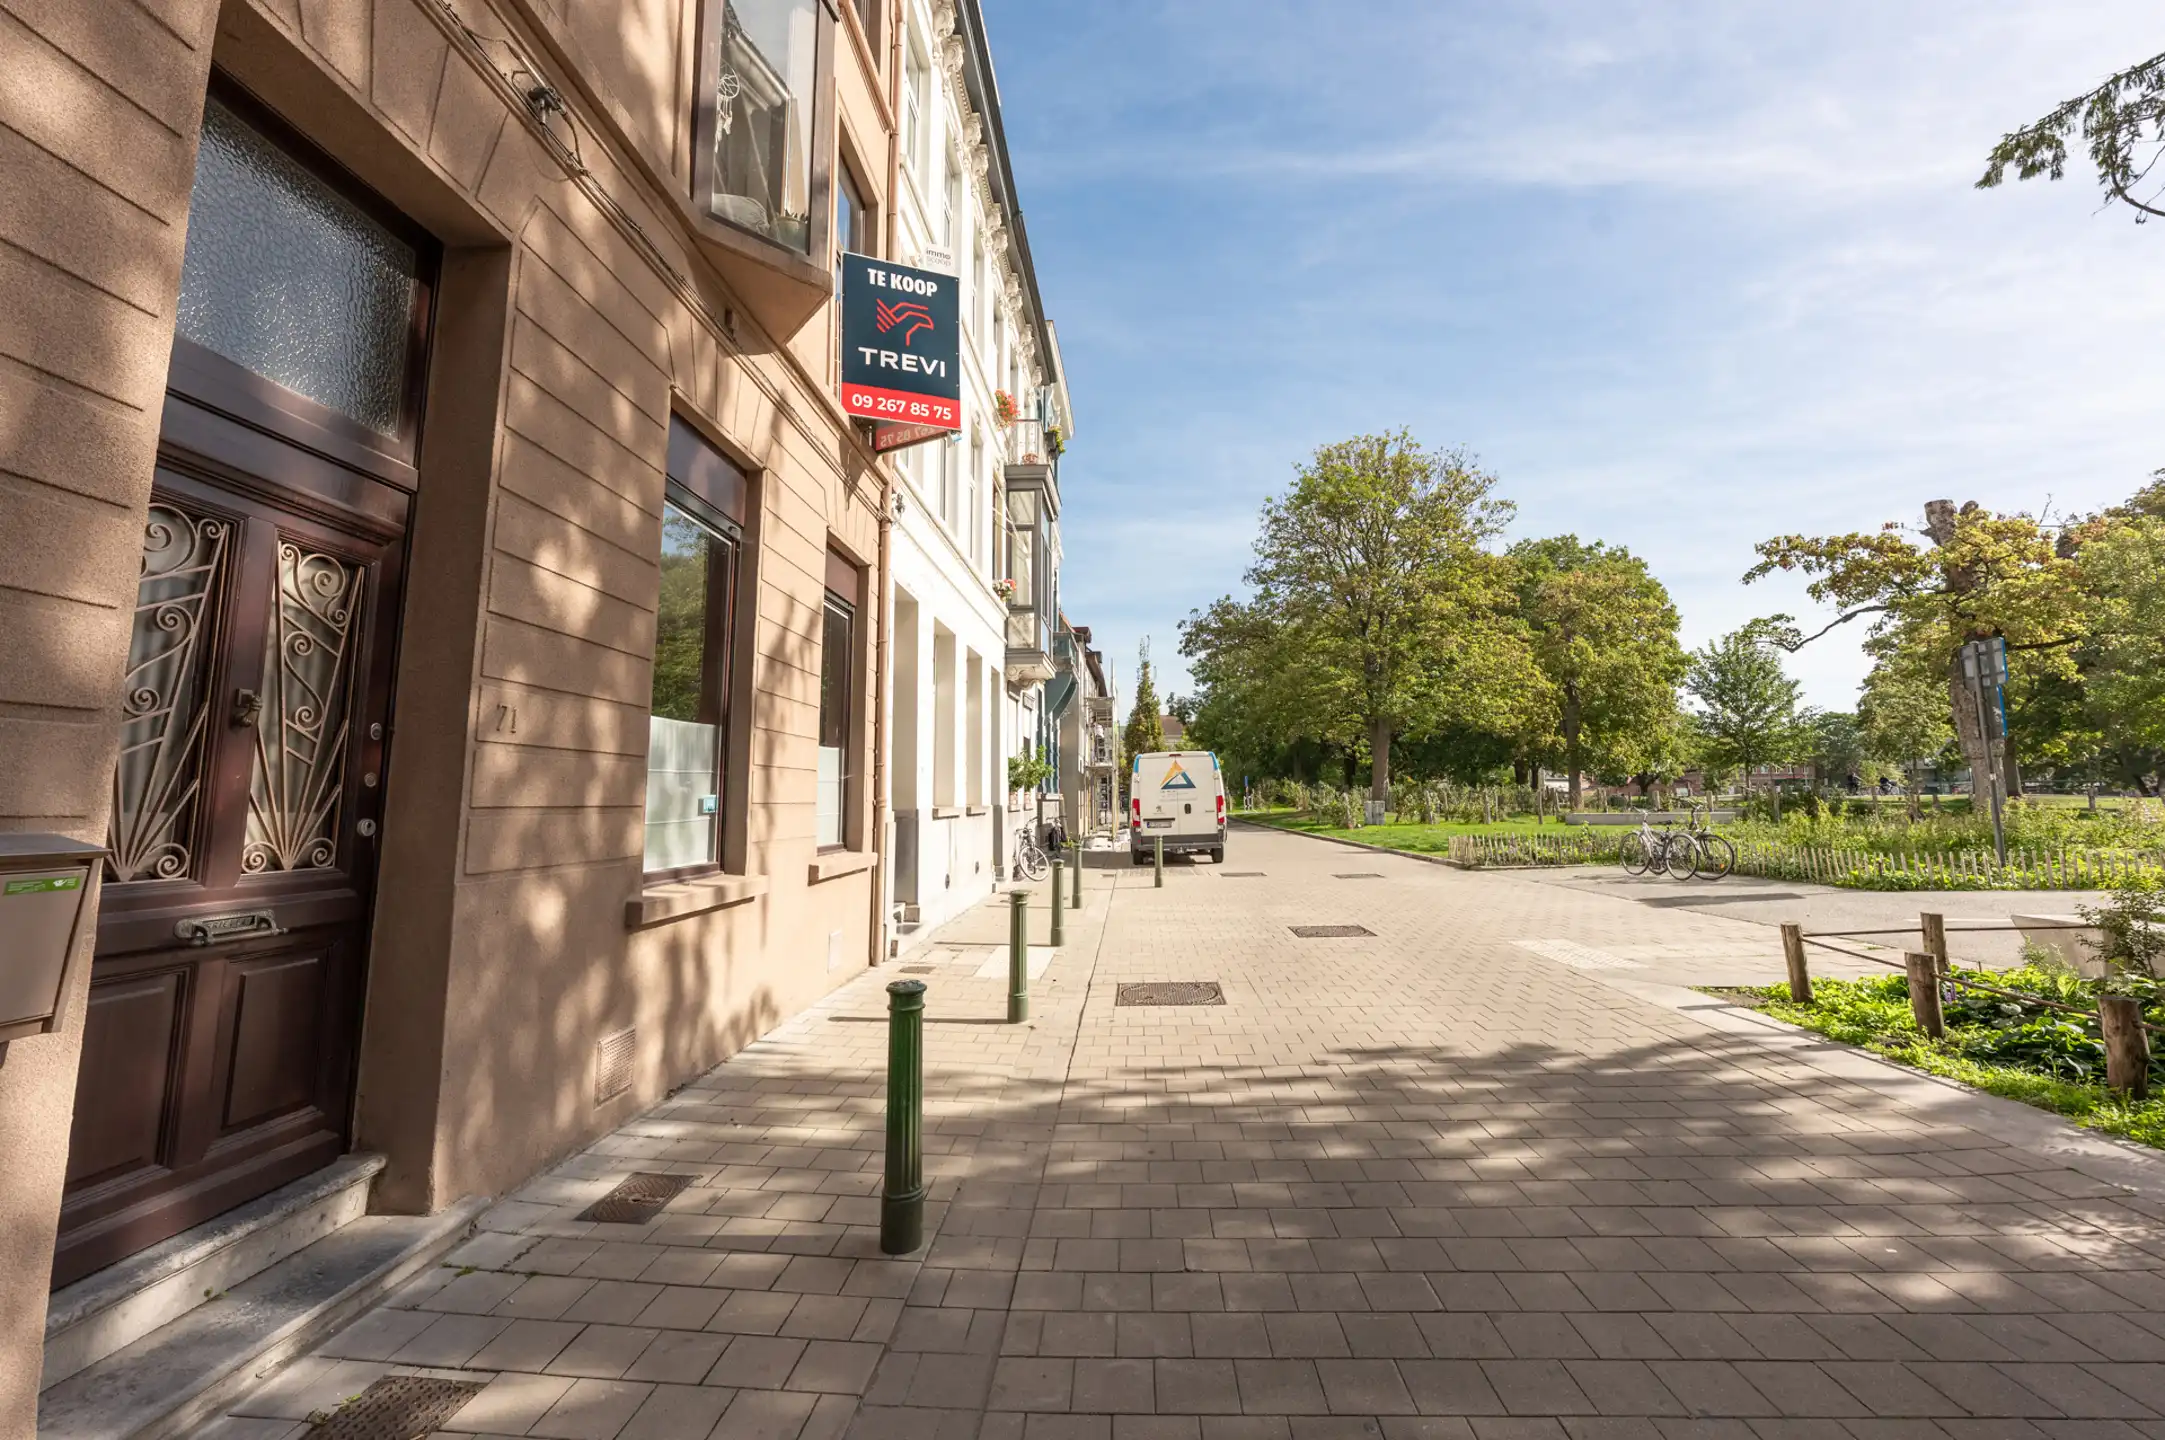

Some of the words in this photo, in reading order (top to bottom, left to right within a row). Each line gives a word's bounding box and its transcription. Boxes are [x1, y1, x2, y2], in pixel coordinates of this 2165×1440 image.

[926, 248, 951, 260] immo
[867, 268, 886, 287] TE
[890, 273, 938, 297] KOOP
[858, 346, 946, 378] TREVI
[852, 393, 873, 408] 09
[877, 397, 906, 413] 267
[910, 402, 930, 417] 85
[933, 405, 952, 420] 75
[496, 704, 517, 734] 71
